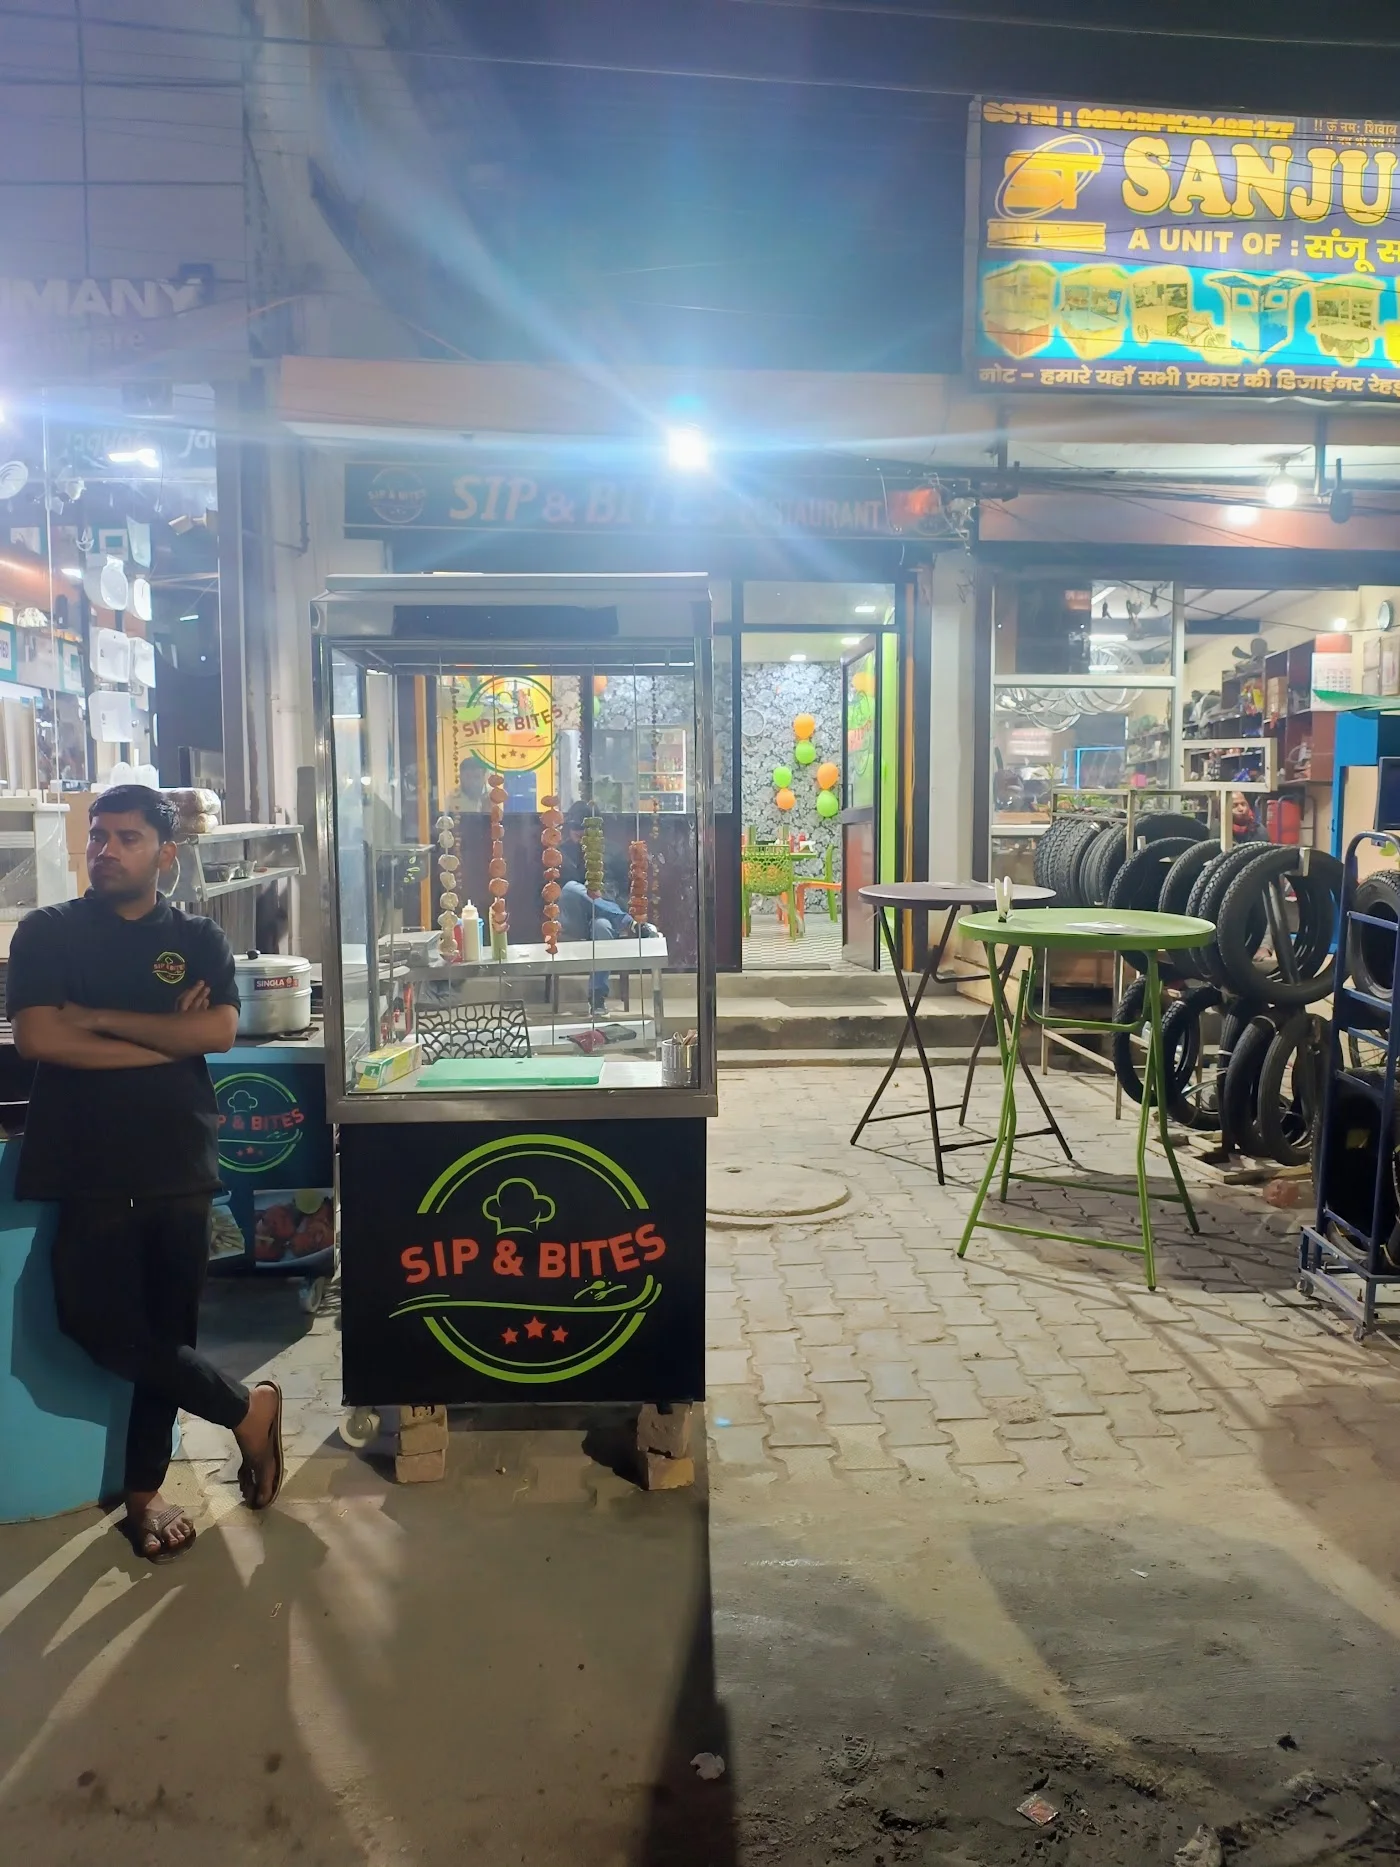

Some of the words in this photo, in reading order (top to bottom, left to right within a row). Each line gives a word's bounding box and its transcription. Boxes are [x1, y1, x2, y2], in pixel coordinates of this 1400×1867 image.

[1122, 136, 1397, 225] SANJU
[1127, 228, 1151, 251] A
[1160, 228, 1234, 254] UNIT
[1242, 231, 1281, 256] OF
[1304, 227, 1376, 273] संजू
[979, 363, 1017, 383] नोट
[1040, 364, 1093, 385] हमारे
[1138, 366, 1181, 387] सभी
[1185, 371, 1241, 390] प्रकार
[1243, 367, 1272, 389] की
[449, 473, 538, 522] SIP
[541, 490, 575, 523] &
[462, 718, 490, 737] SIP
[497, 718, 509, 731] &
[514, 704, 562, 731] BITES
[256, 979, 285, 988] SINGLA
[232, 1115, 245, 1131] &
[251, 1108, 304, 1131] BITES
[400, 1238, 480, 1284] SIP
[493, 1239, 524, 1278] &
[539, 1223, 667, 1278] BITES
